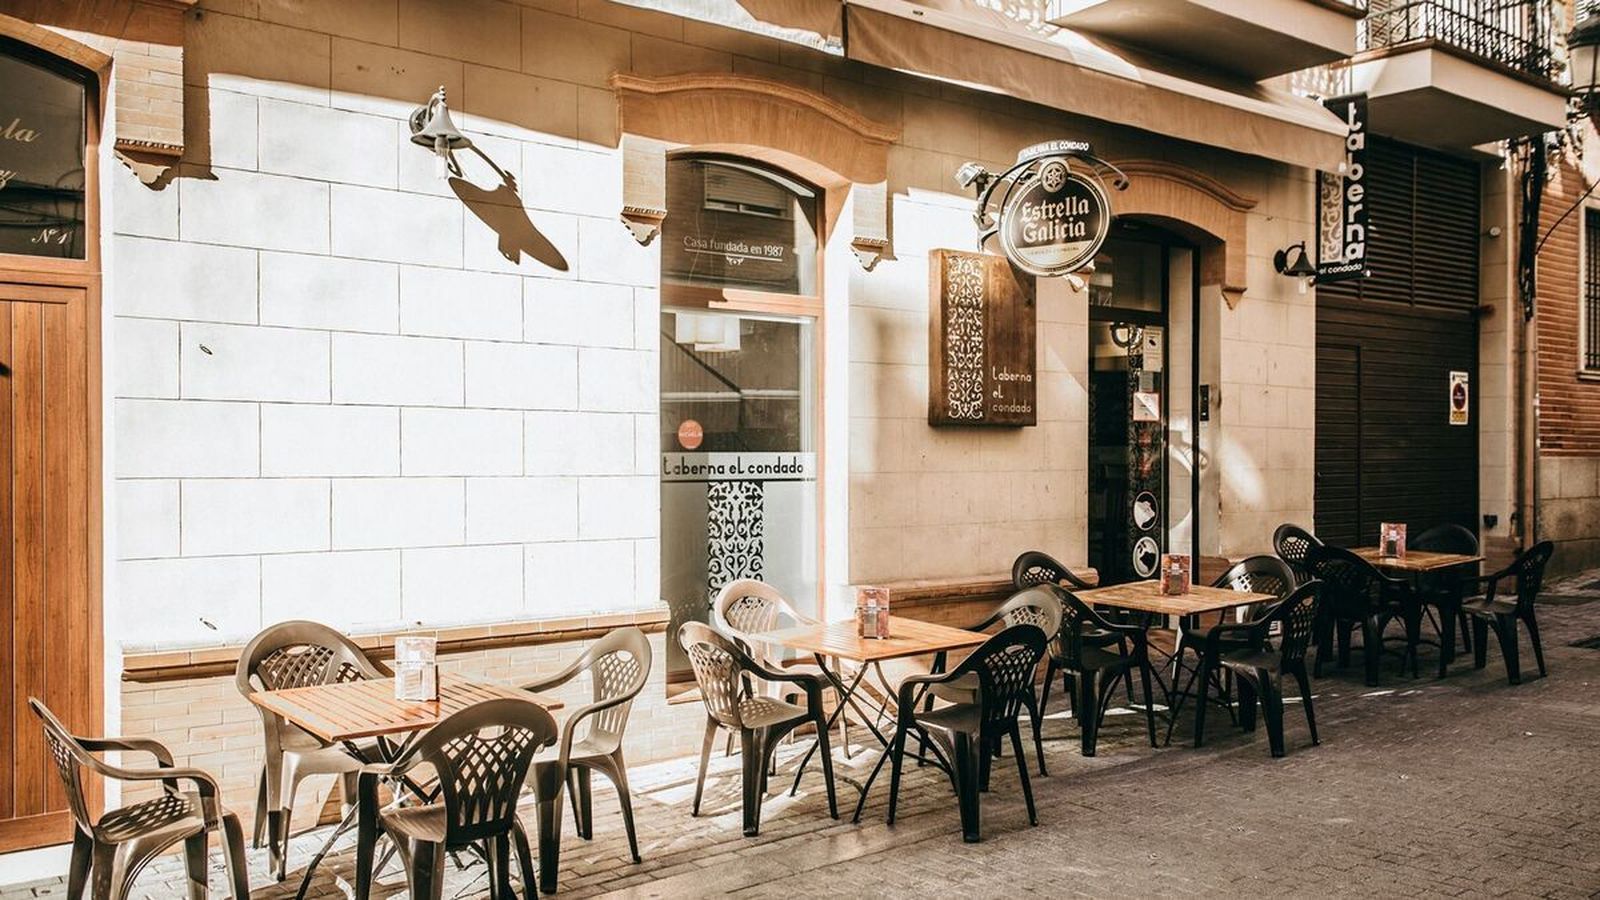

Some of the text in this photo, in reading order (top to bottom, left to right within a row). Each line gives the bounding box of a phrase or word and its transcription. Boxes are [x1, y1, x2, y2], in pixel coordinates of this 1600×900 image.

[1346, 102, 1365, 261] taberna
[1021, 196, 1089, 223] Estrella
[1023, 218, 1086, 244] Galicia
[683, 235, 784, 257] Casa fundada en 1987
[1327, 263, 1363, 274] condado
[992, 398, 1032, 413] condado
[747, 456, 804, 474] condado
